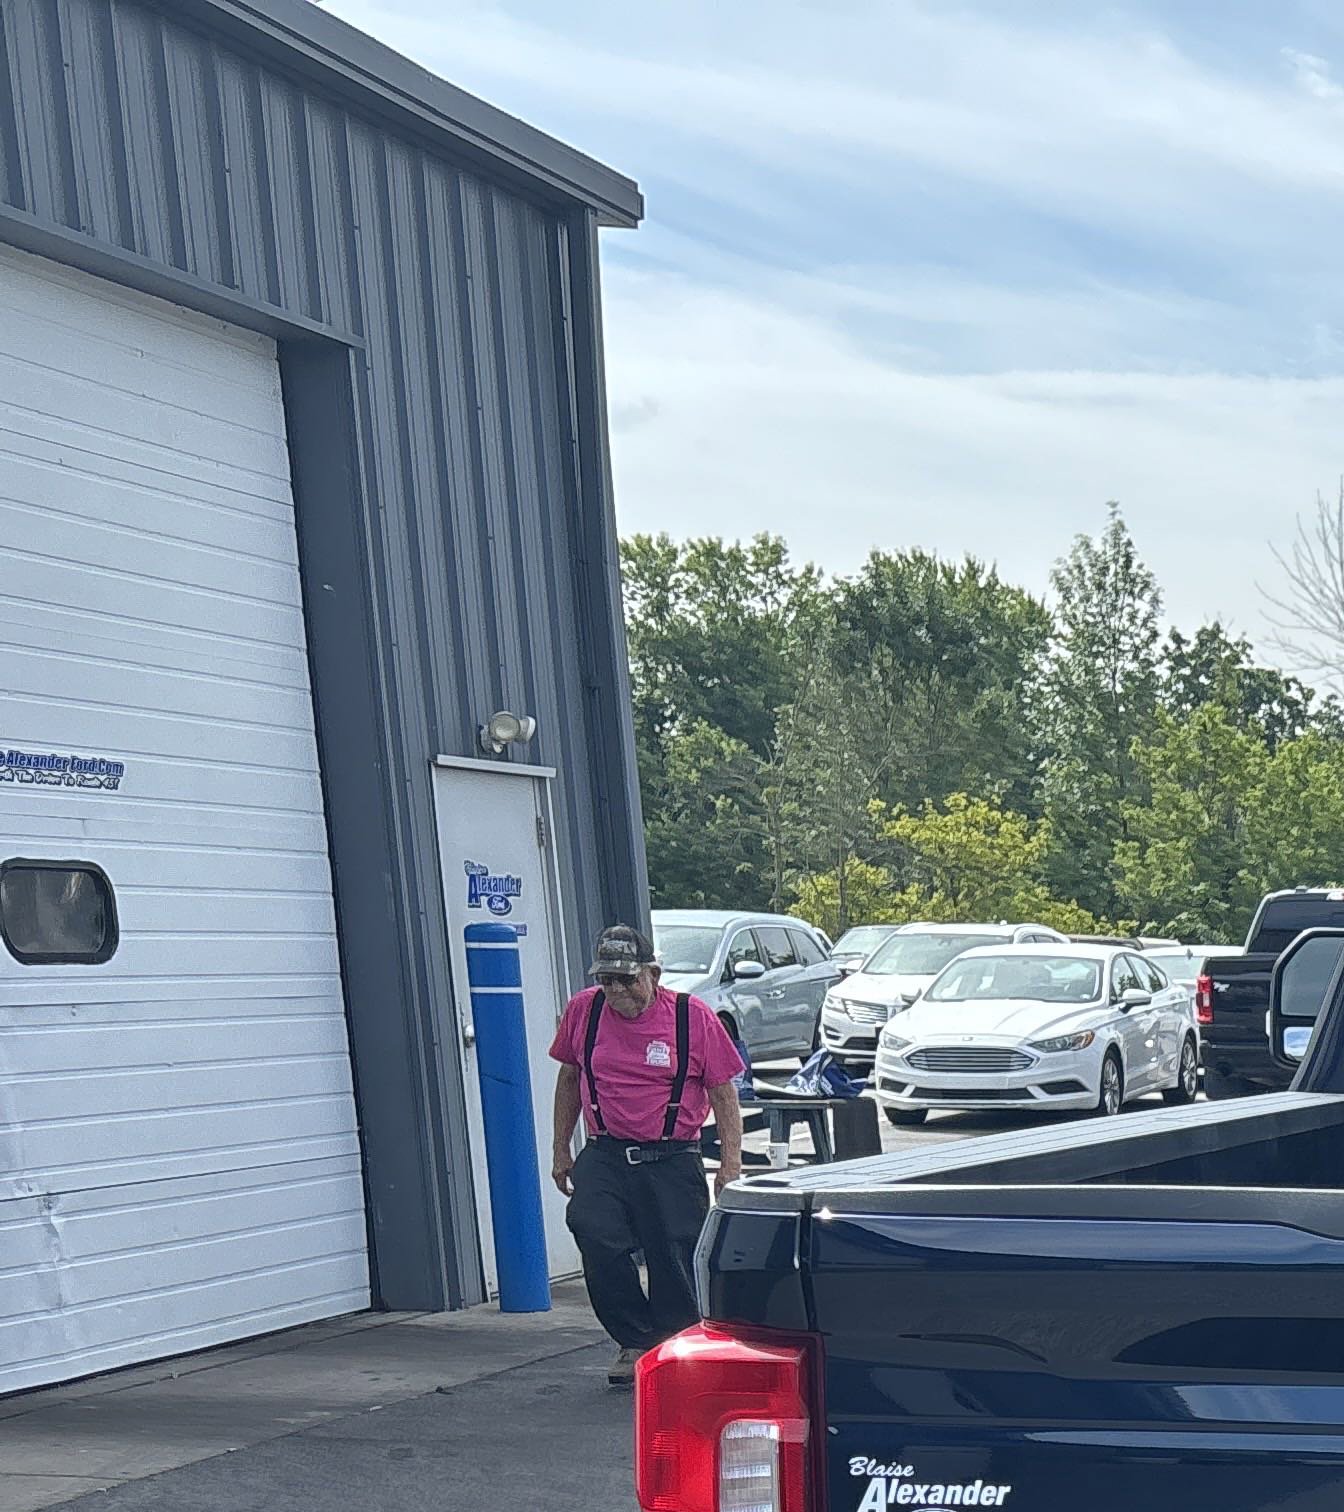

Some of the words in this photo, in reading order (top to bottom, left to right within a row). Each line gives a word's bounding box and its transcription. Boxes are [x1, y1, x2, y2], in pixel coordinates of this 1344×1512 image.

[7, 750, 68, 772] Alexander
[467, 874, 522, 908] Alexander
[848, 1456, 915, 1477] Blaise
